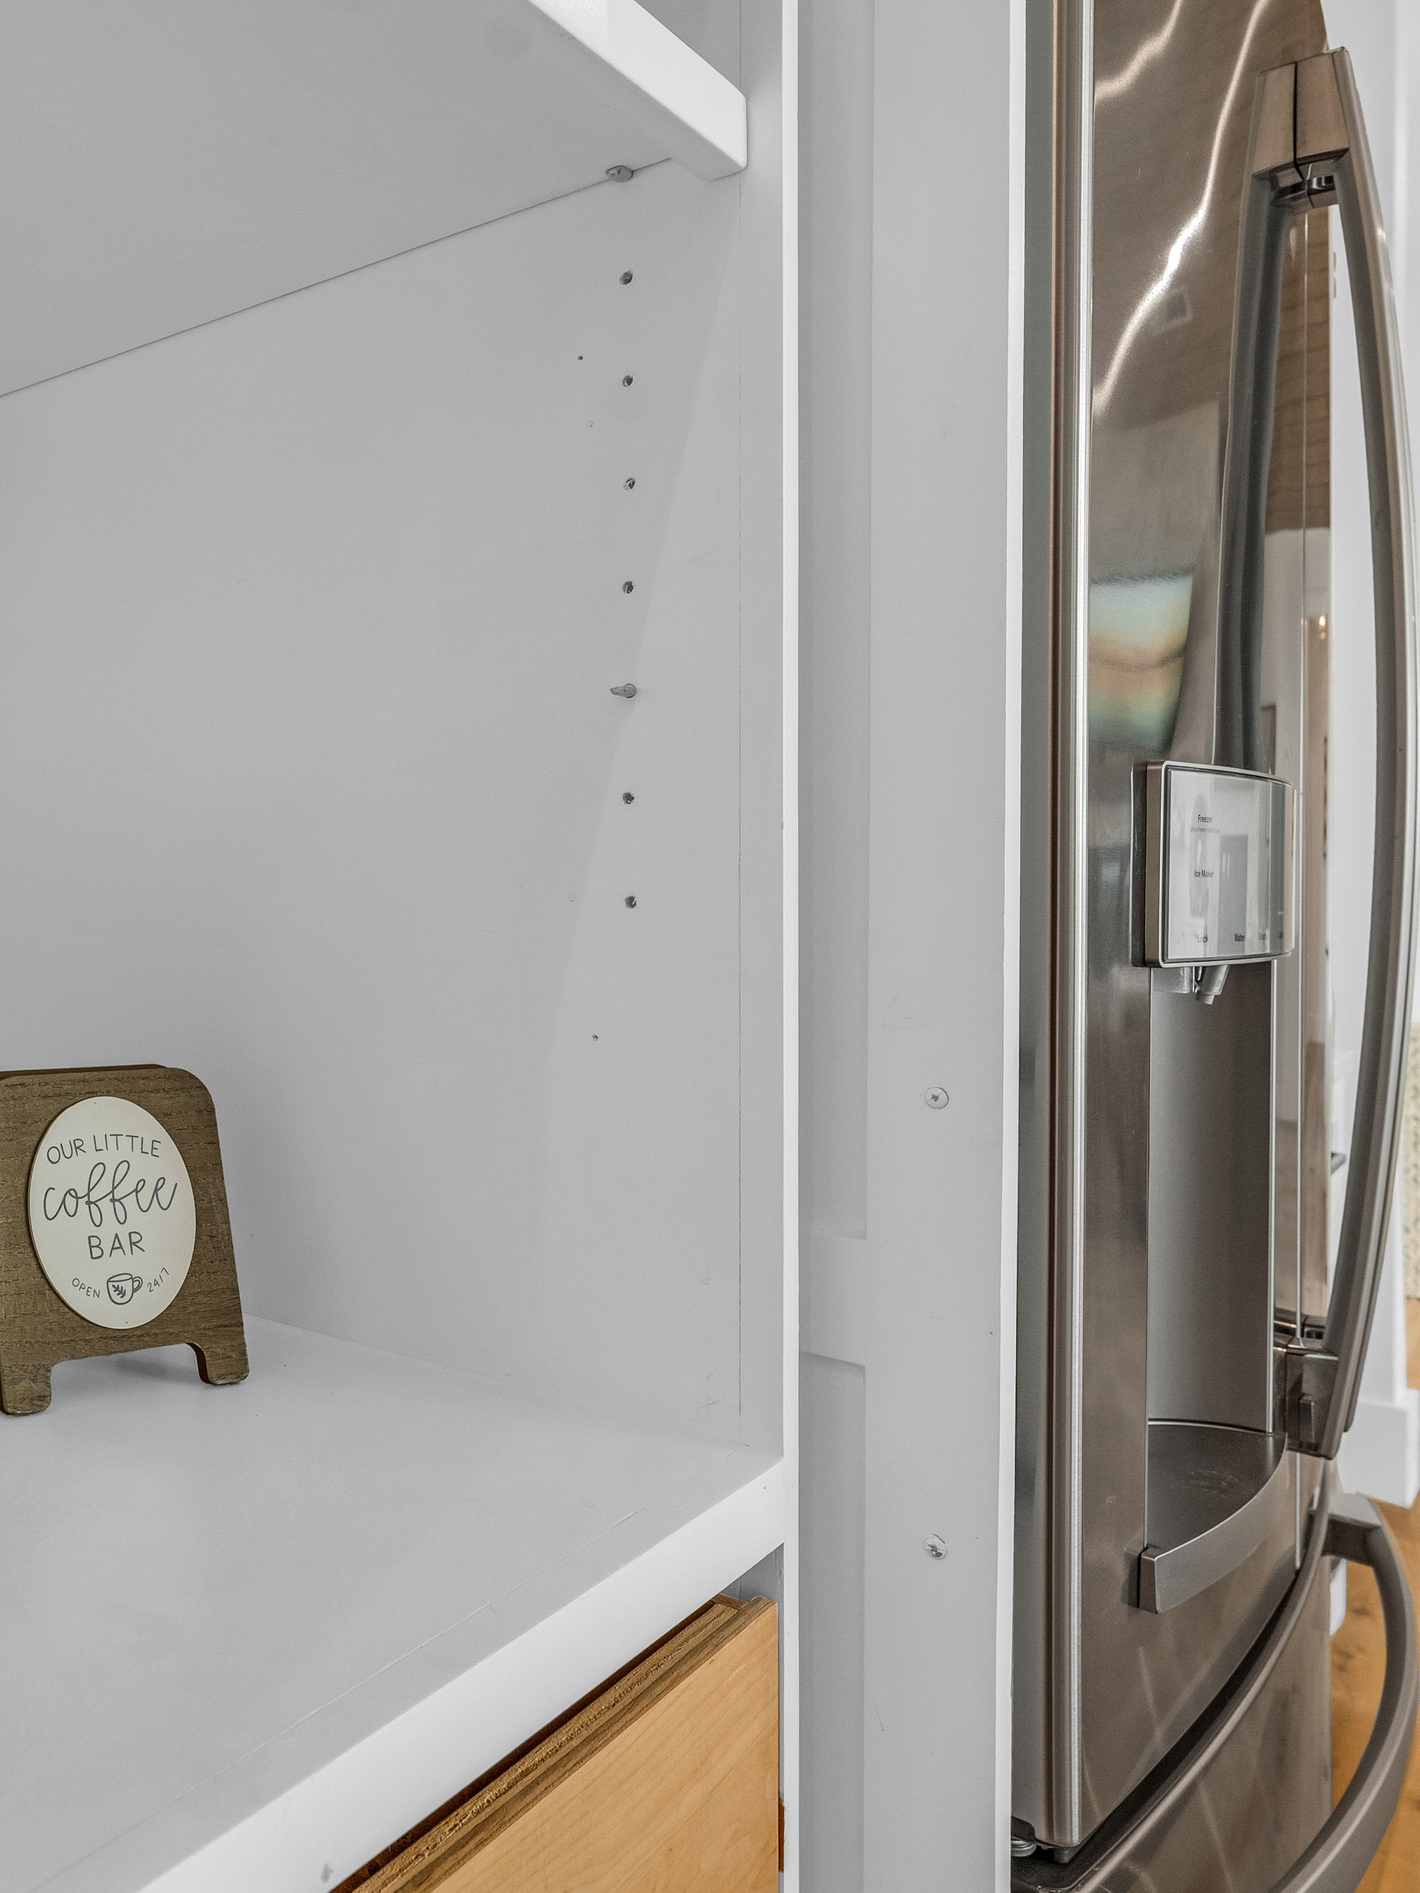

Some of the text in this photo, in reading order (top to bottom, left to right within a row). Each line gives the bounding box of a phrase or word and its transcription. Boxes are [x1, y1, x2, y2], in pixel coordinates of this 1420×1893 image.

[46, 1133, 162, 1164] OUR LITTLE
[43, 1159, 178, 1227] coffee
[87, 1231, 146, 1260] BAR
[71, 1277, 101, 1298] OPEN
[146, 1267, 170, 1293] 24/7
